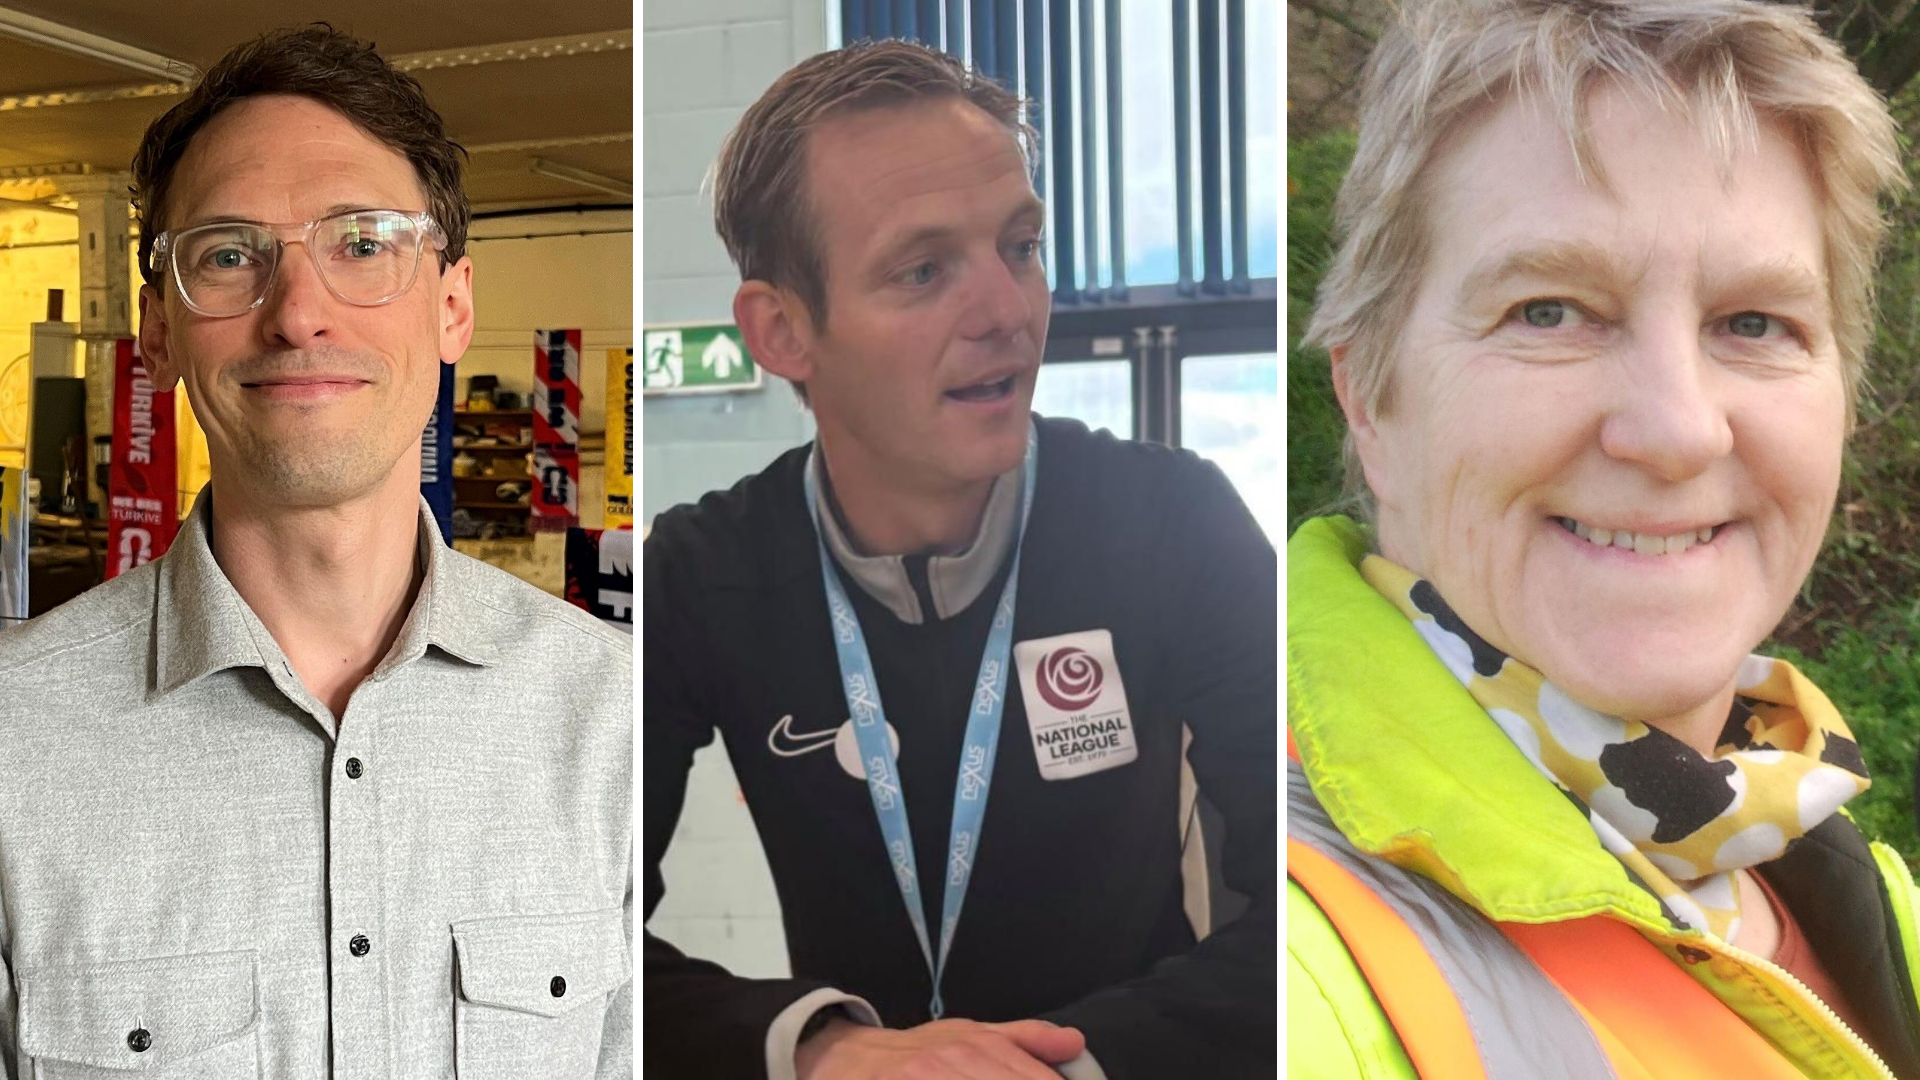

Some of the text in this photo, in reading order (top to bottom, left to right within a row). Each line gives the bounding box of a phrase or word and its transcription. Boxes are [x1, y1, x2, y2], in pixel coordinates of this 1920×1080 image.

[1036, 717, 1127, 746] NATIONAL
[1069, 714, 1088, 725] THE
[1049, 733, 1111, 759] LEAGUE
